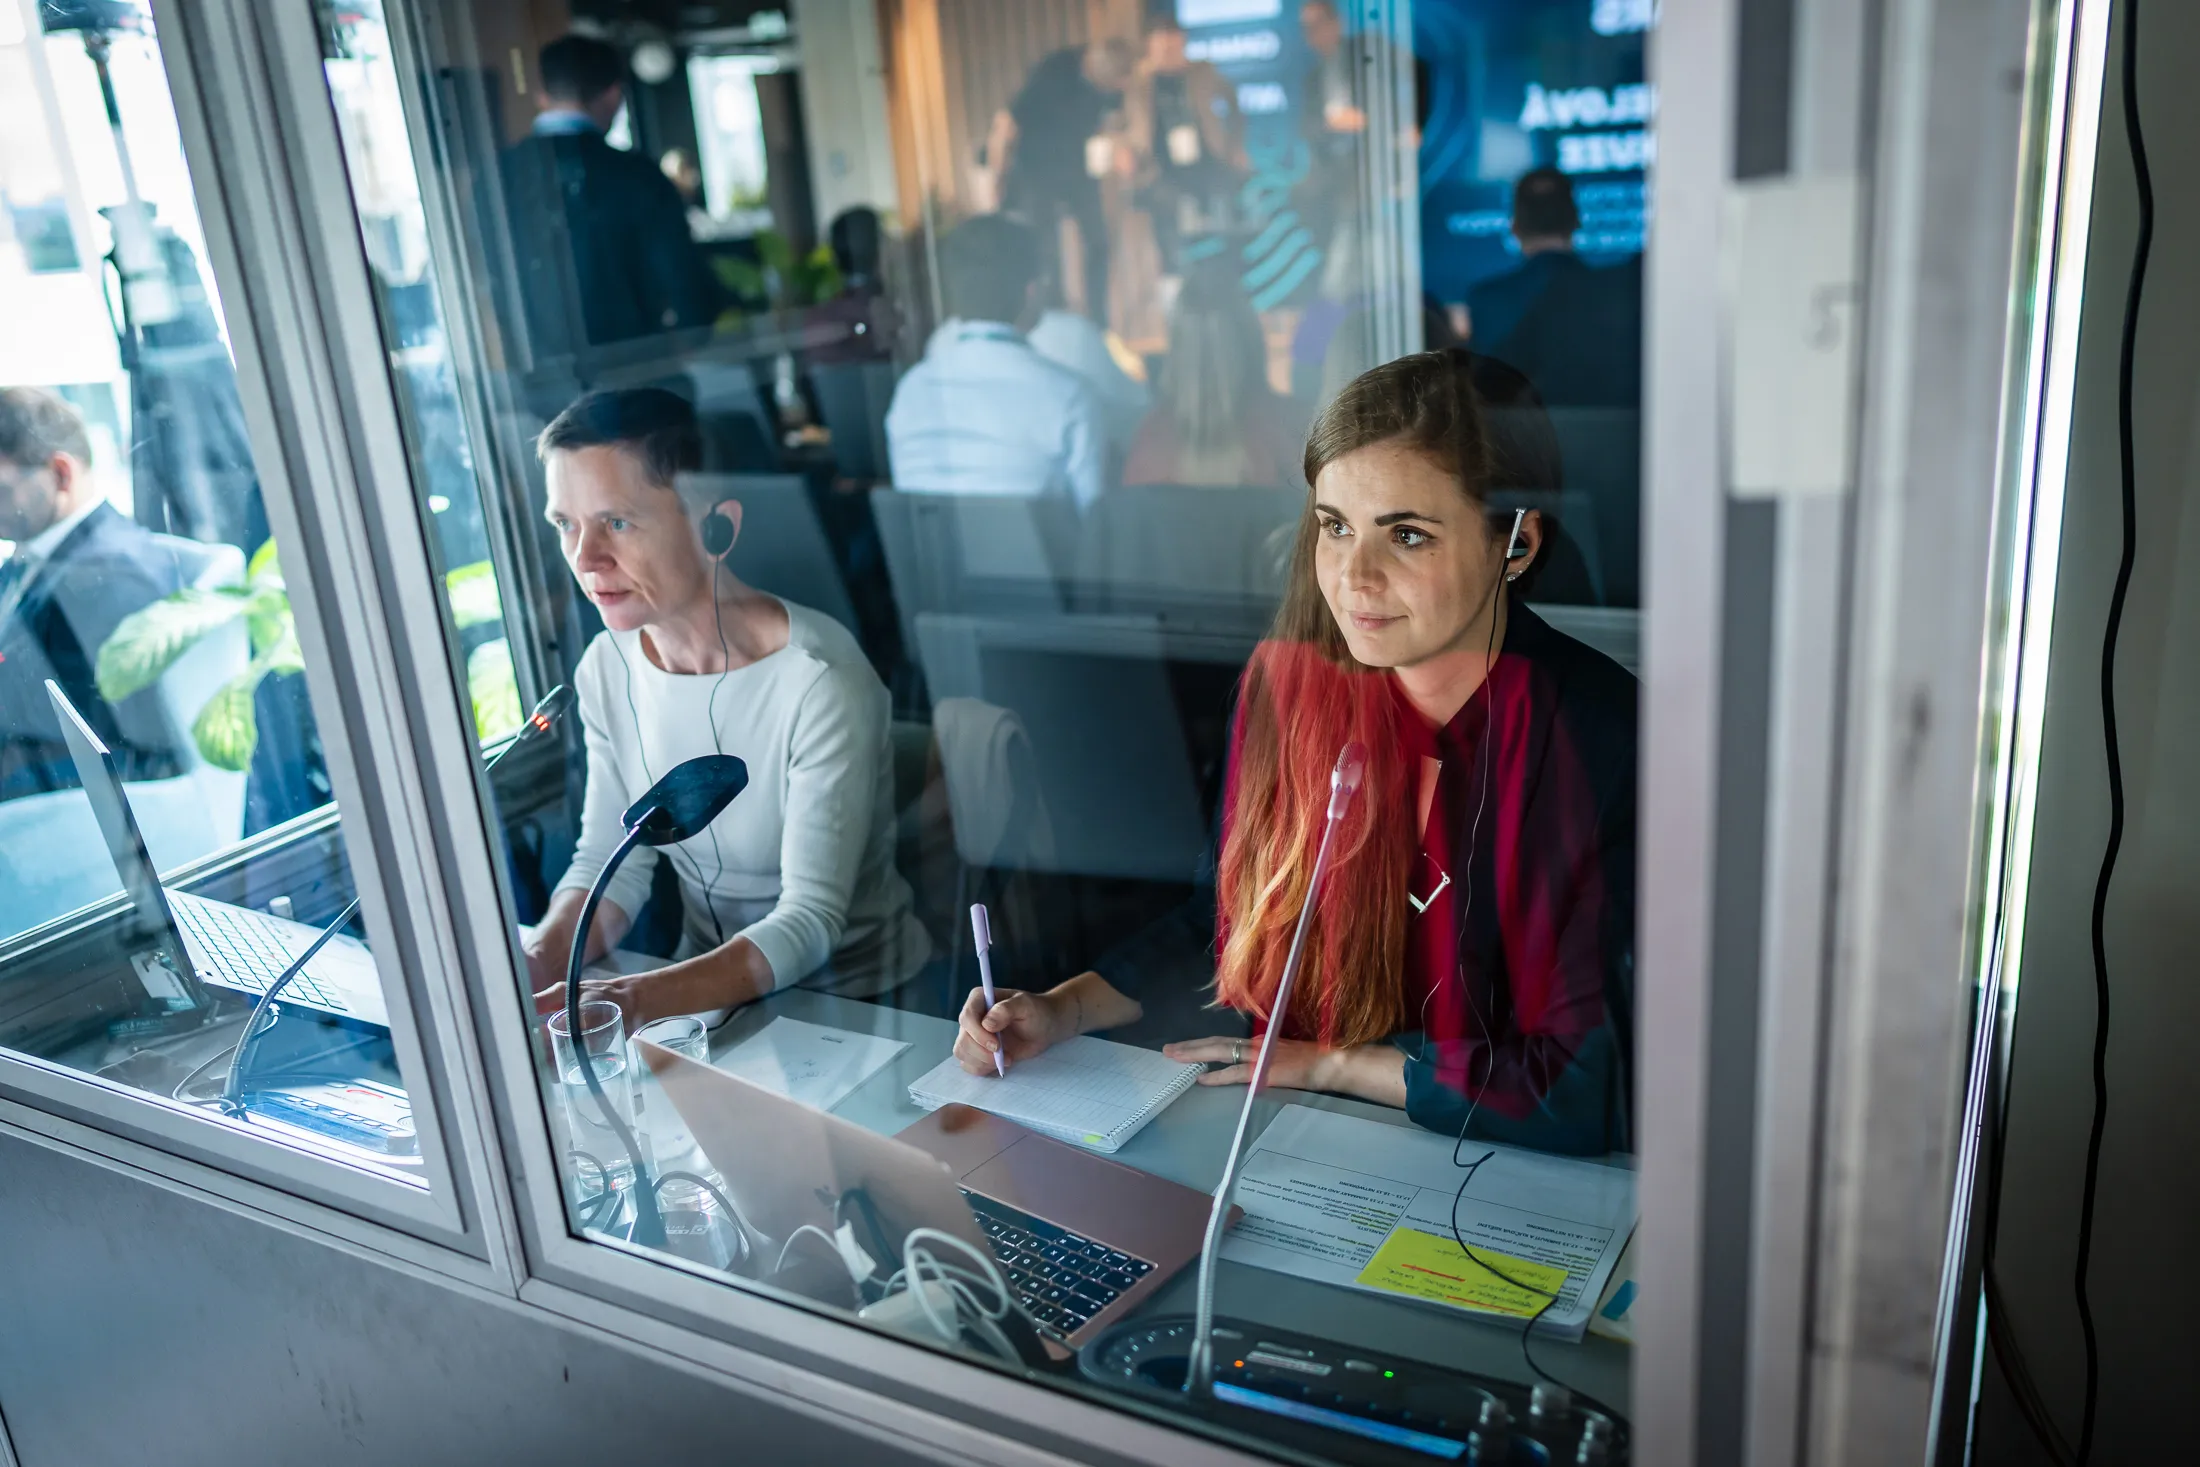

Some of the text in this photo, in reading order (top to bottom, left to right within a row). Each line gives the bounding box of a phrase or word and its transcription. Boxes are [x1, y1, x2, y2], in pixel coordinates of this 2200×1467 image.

[1289, 1178, 1316, 1187] MESSAGES
[1339, 1181, 1374, 1192] NETWORKING
[1341, 1191, 1368, 1200] SUMMARY
[1526, 1223, 1566, 1235] NETWORKING
